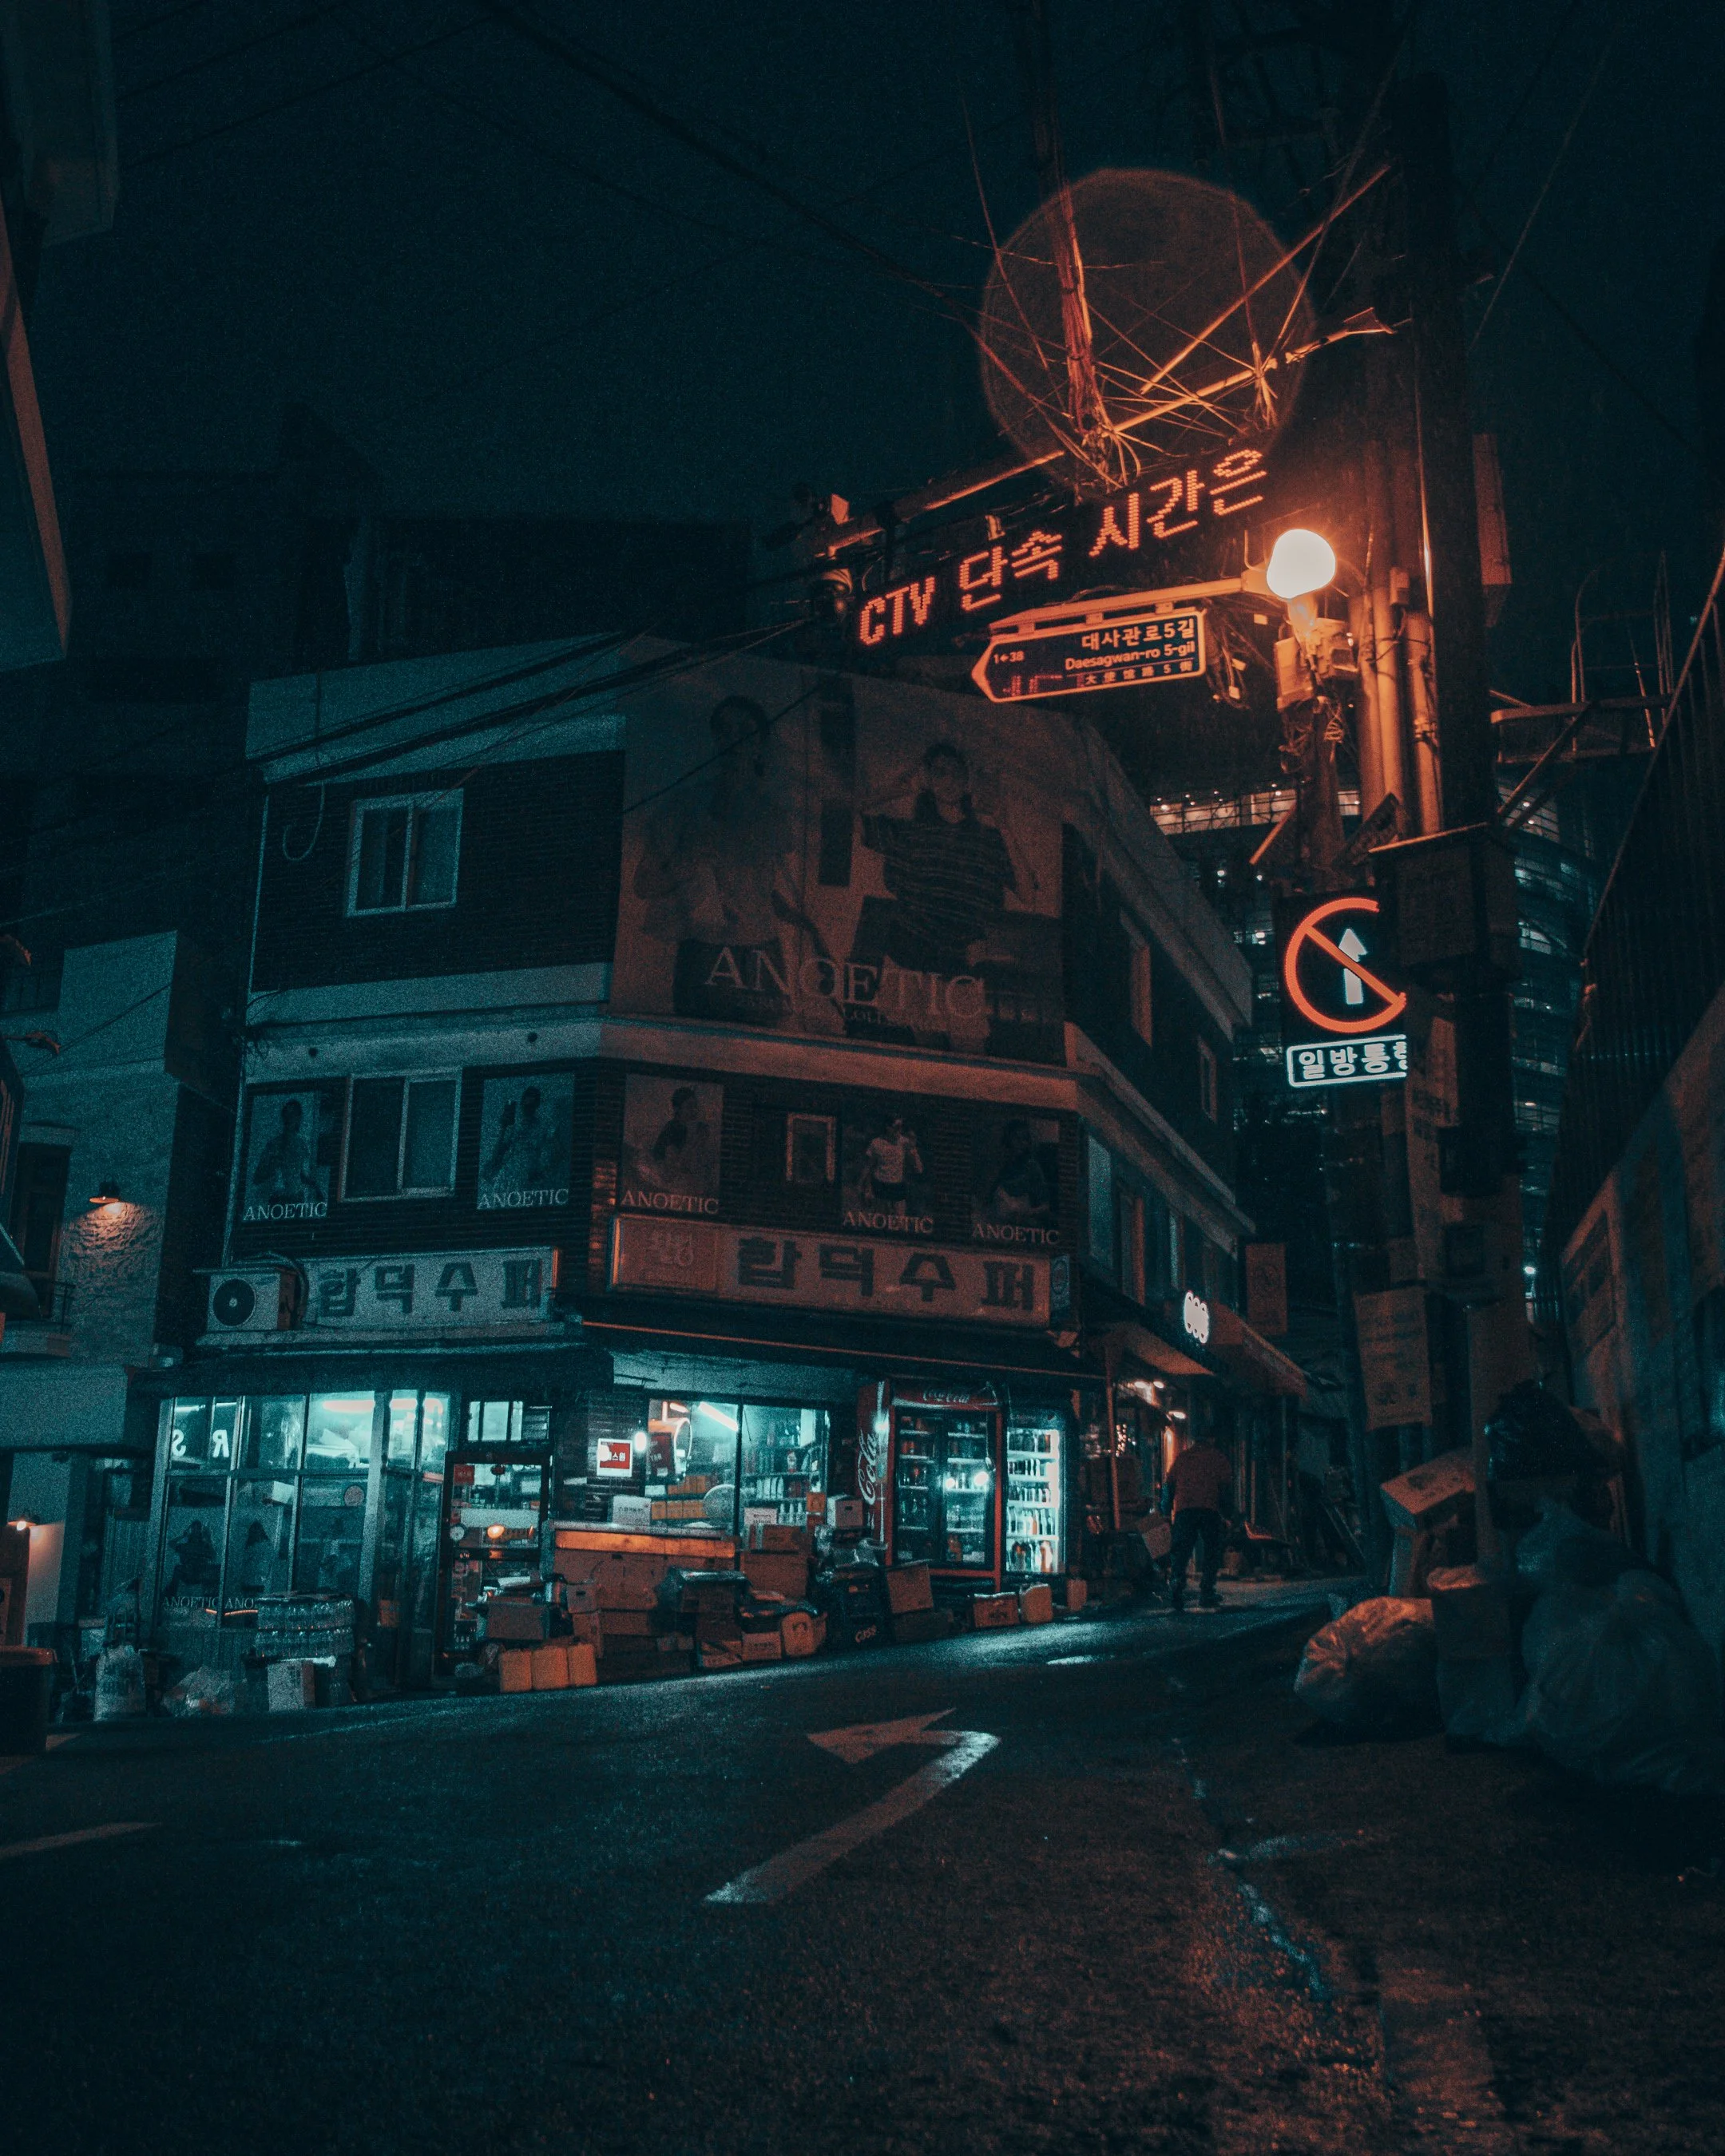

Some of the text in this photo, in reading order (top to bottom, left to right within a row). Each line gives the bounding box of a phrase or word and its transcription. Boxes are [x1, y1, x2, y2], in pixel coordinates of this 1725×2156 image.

[959, 530, 1063, 612] 단속
[1089, 448, 1267, 557] 시간은
[1081, 618, 1196, 651] 대사관로5길
[1065, 641, 1196, 671] Daesagwan-ro 5-gil
[704, 946, 985, 1018] ANOETIC
[243, 1202, 328, 1221] ANOETIC
[477, 1188, 569, 1210] ANOETIC
[621, 1190, 719, 1215] ANOETIC
[842, 1208, 934, 1234] ANOETIC
[972, 1222, 1061, 1246] ANOETIC
